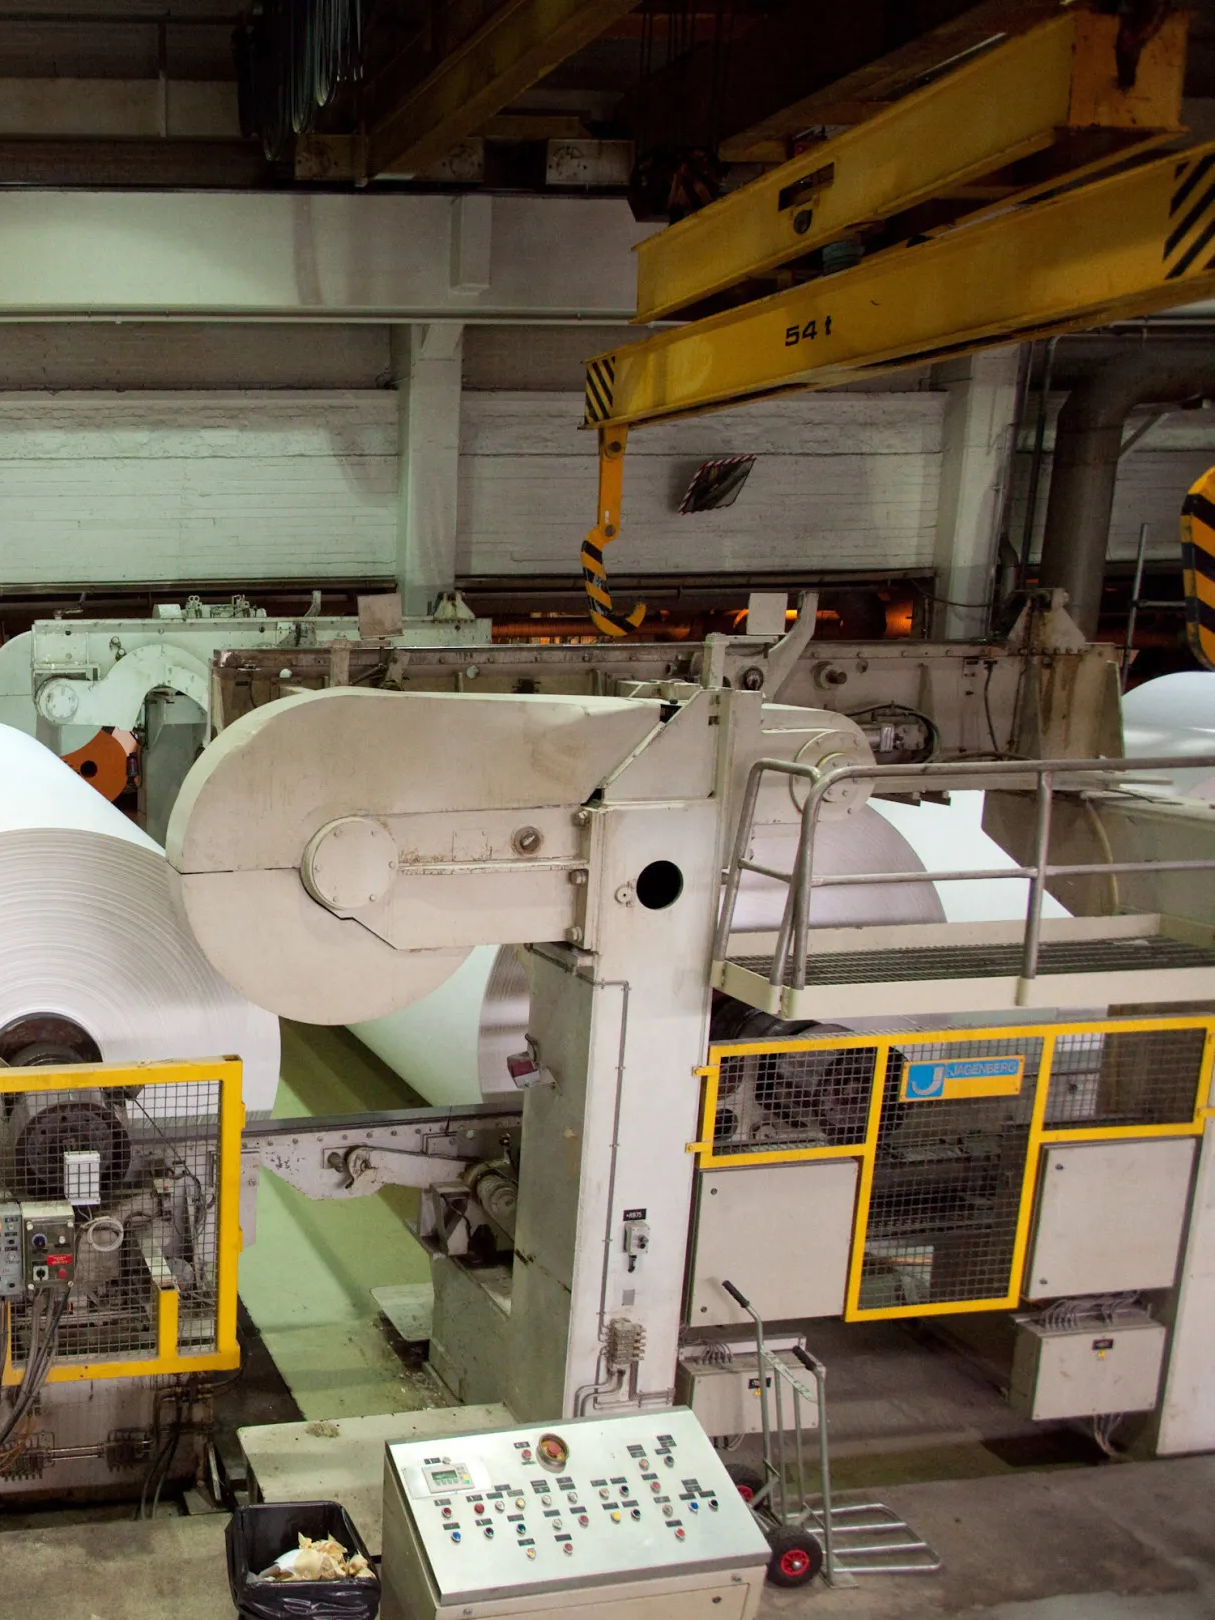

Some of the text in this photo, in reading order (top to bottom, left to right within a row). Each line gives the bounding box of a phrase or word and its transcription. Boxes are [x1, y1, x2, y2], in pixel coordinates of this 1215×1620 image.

[785, 315, 832, 347] 54 t
[949, 1060, 1017, 1077] JAGENBERG
